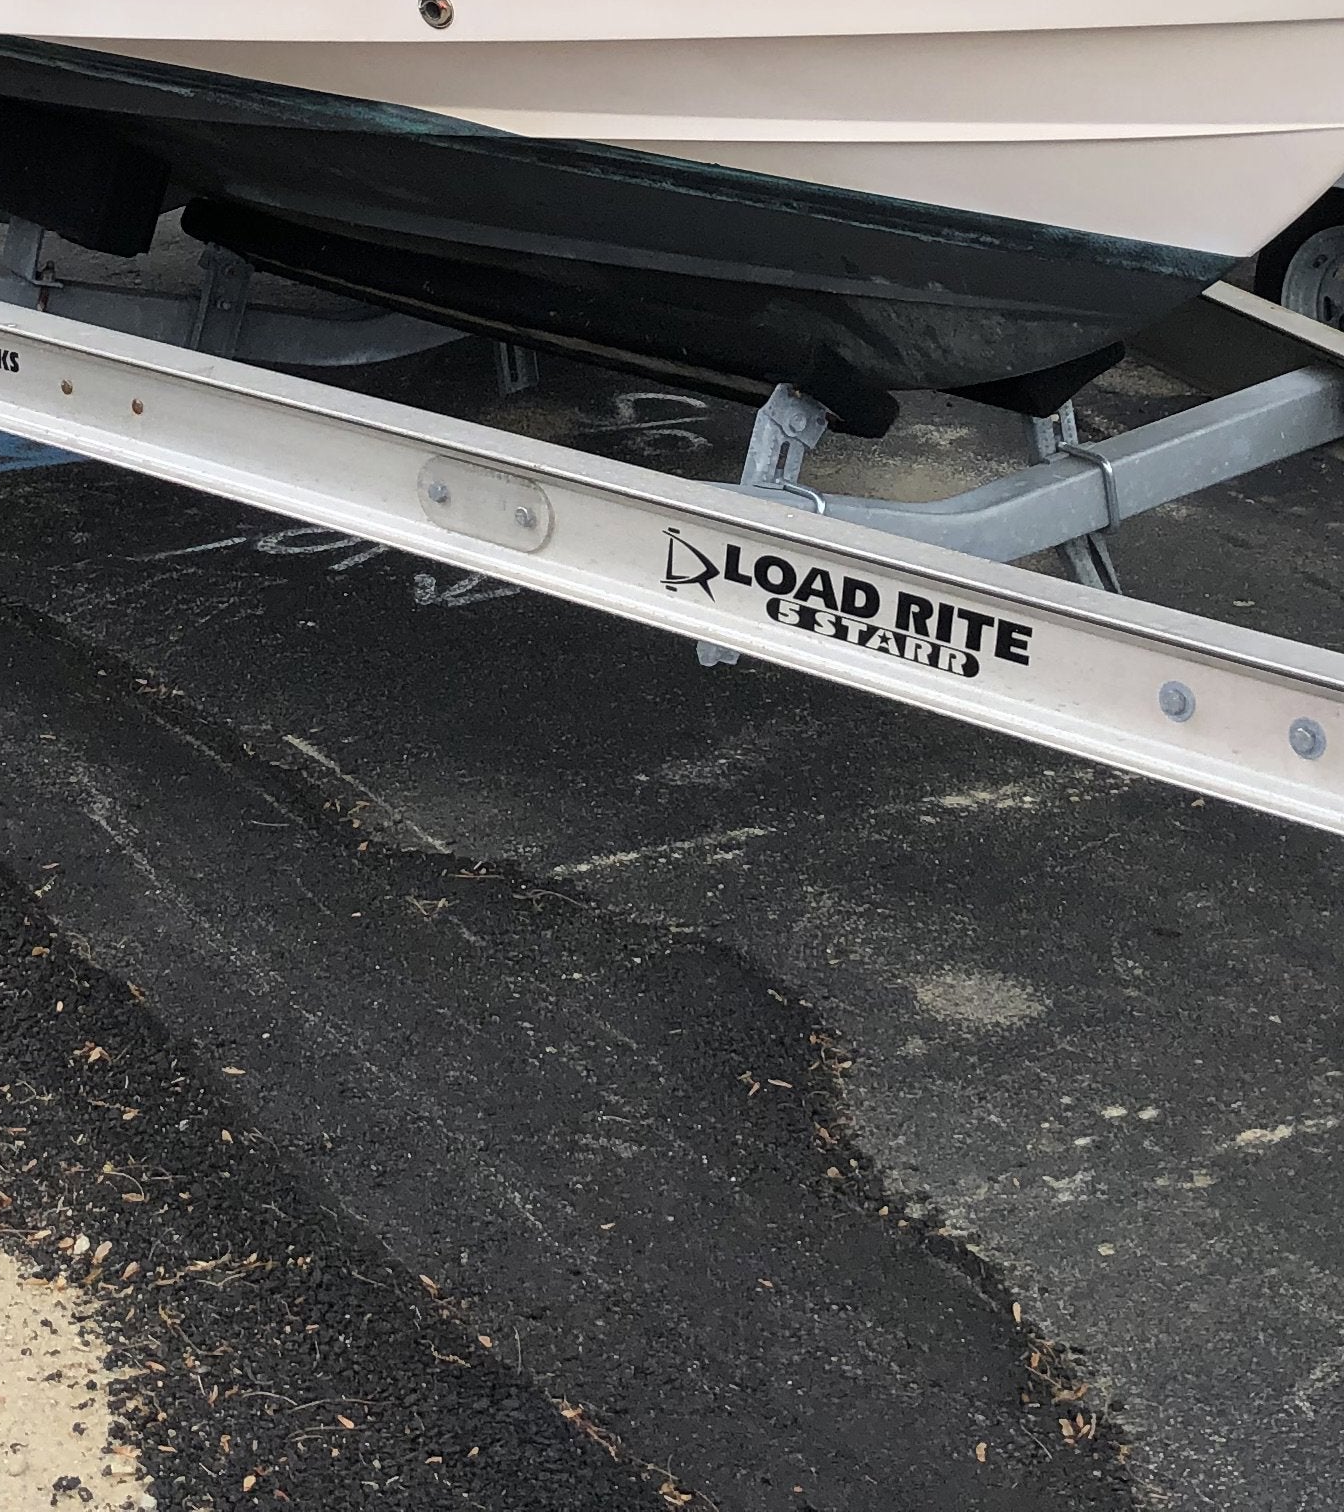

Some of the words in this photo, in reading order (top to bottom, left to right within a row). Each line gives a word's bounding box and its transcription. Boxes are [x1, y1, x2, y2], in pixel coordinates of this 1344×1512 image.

[724, 544, 881, 619] LOAD
[895, 590, 1033, 666] RITE
[777, 603, 801, 625] 5
